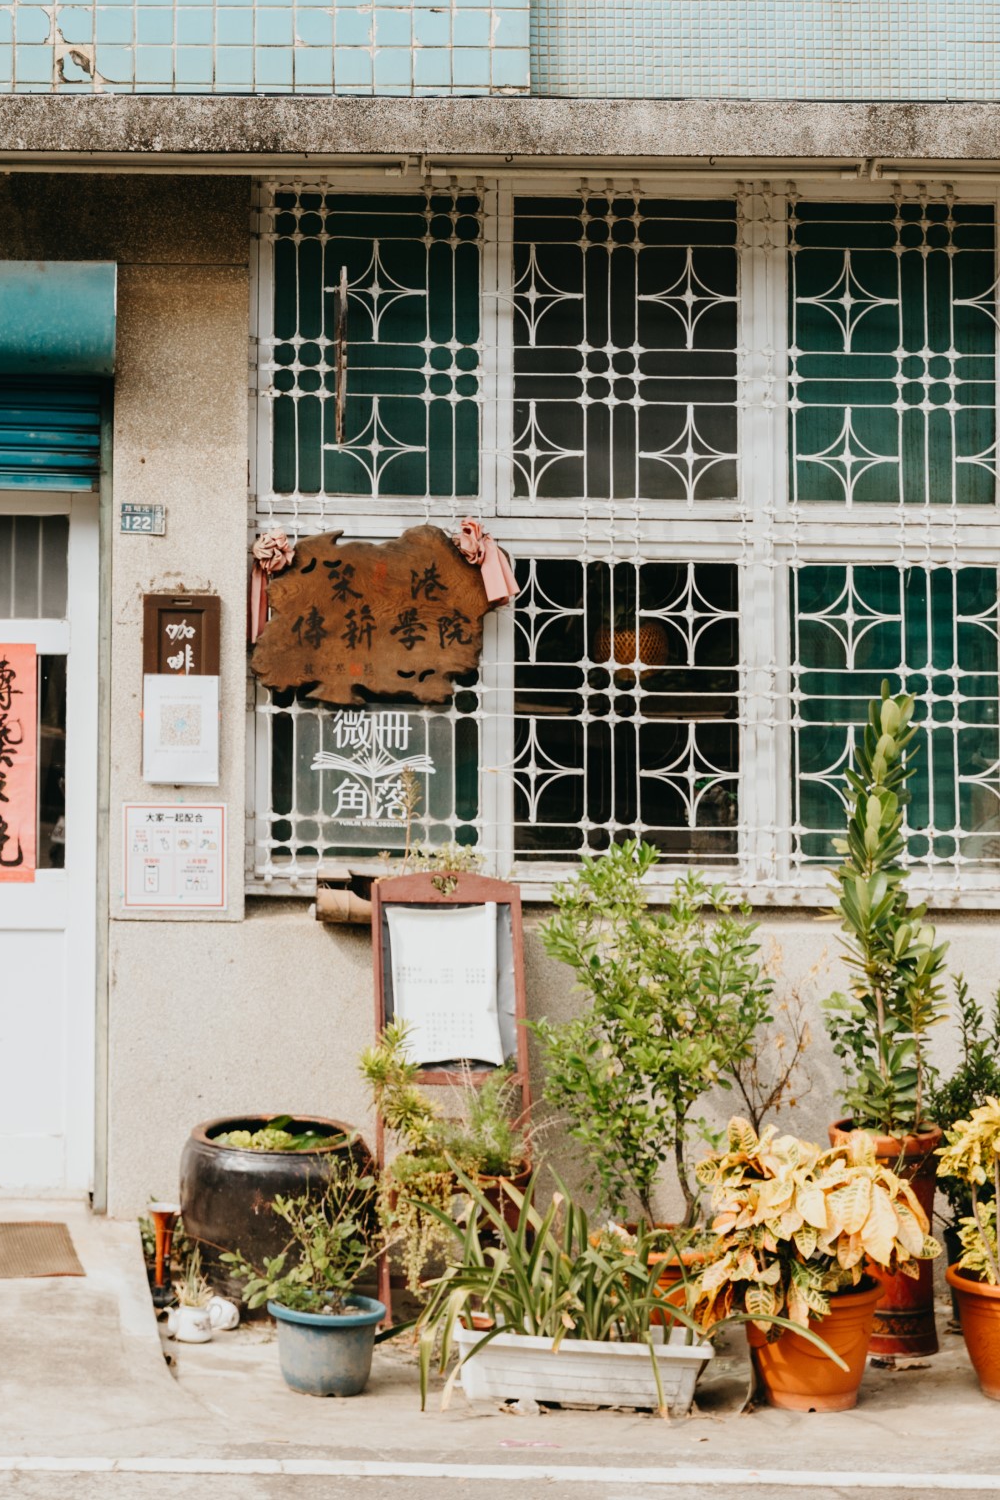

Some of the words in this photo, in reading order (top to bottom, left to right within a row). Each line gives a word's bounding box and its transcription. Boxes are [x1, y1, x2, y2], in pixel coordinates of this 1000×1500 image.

[125, 516, 151, 530] 122
[165, 619, 196, 674] 咖啡
[331, 778, 408, 819] 角落
[146, 812, 204, 823] 大家一起配合
